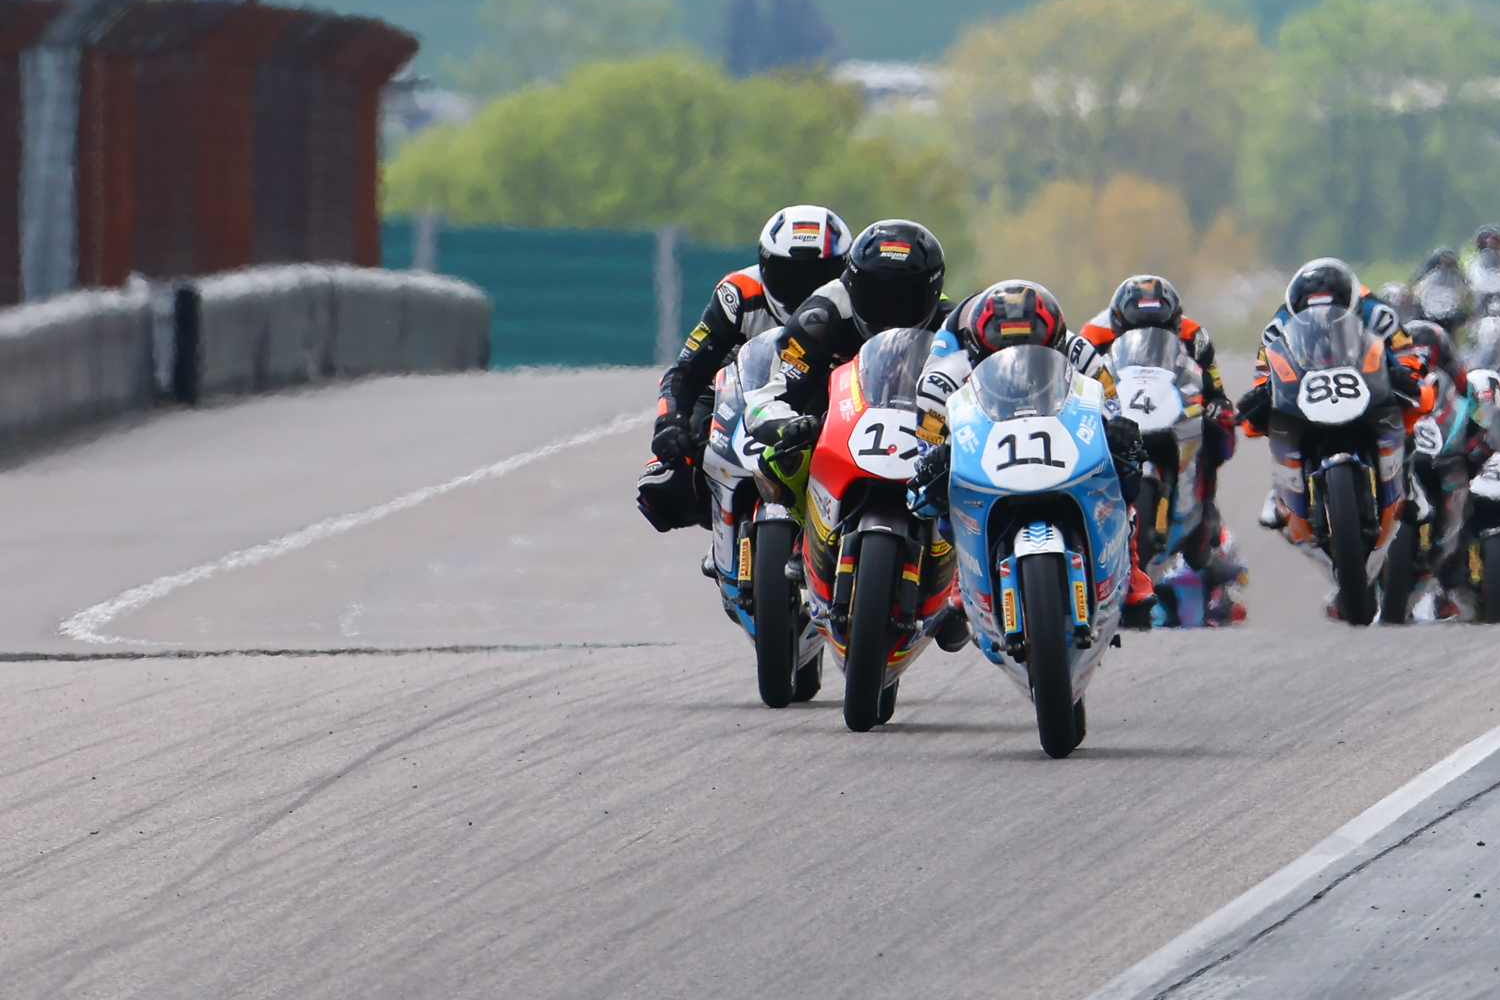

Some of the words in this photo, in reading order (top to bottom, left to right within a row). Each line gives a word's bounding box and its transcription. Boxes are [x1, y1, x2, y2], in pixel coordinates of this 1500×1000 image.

[880, 252, 909, 260] NOLAN
[1129, 388, 1157, 415] 4
[1307, 373, 1361, 403] 88
[928, 408, 946, 423] ADAC
[996, 431, 1066, 472] 11
[1003, 591, 1015, 627] PIRELLI
[1075, 585, 1087, 620] PIRELLI
